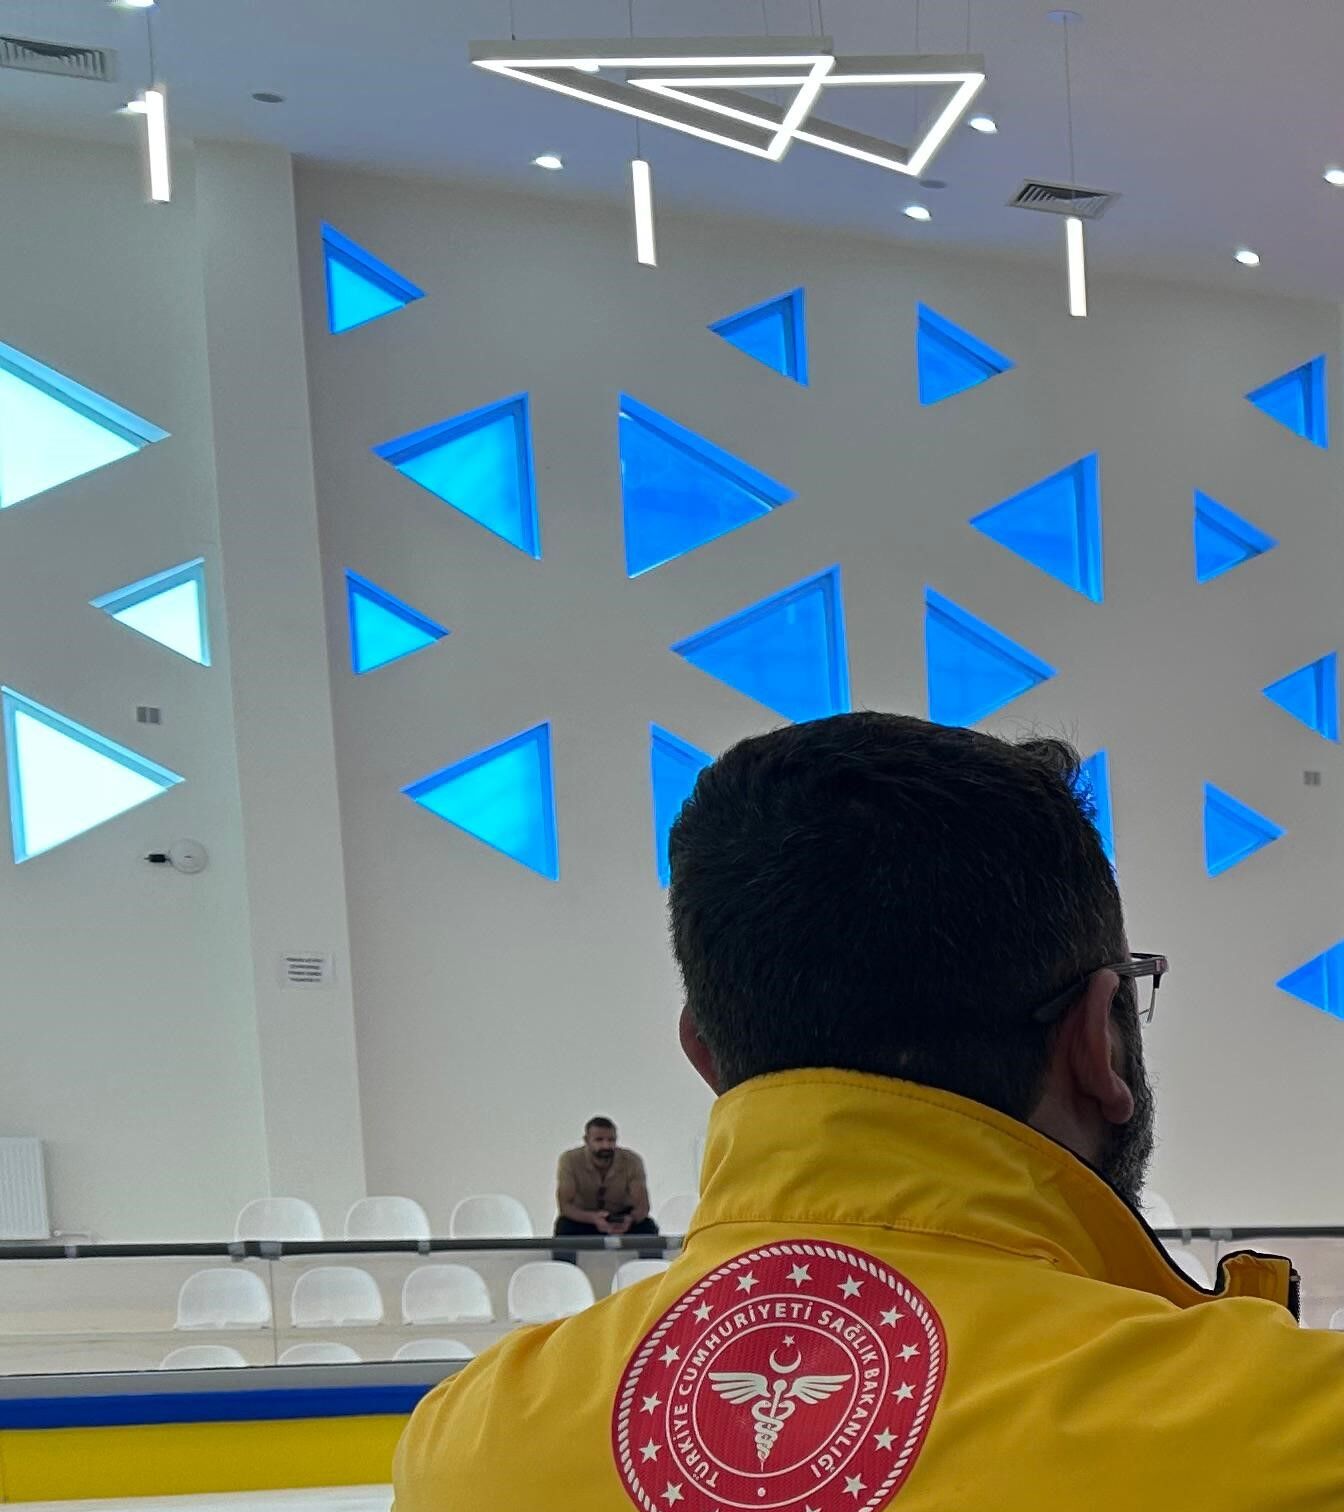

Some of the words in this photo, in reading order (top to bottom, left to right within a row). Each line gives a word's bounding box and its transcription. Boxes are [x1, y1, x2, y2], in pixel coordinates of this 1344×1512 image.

[678, 1301, 814, 1397] CUMHURİYETİ
[817, 1308, 880, 1366] SAĞLIK
[673, 1403, 719, 1489] TÜRKİYE
[810, 1366, 881, 1479] BAKANLIĞI
